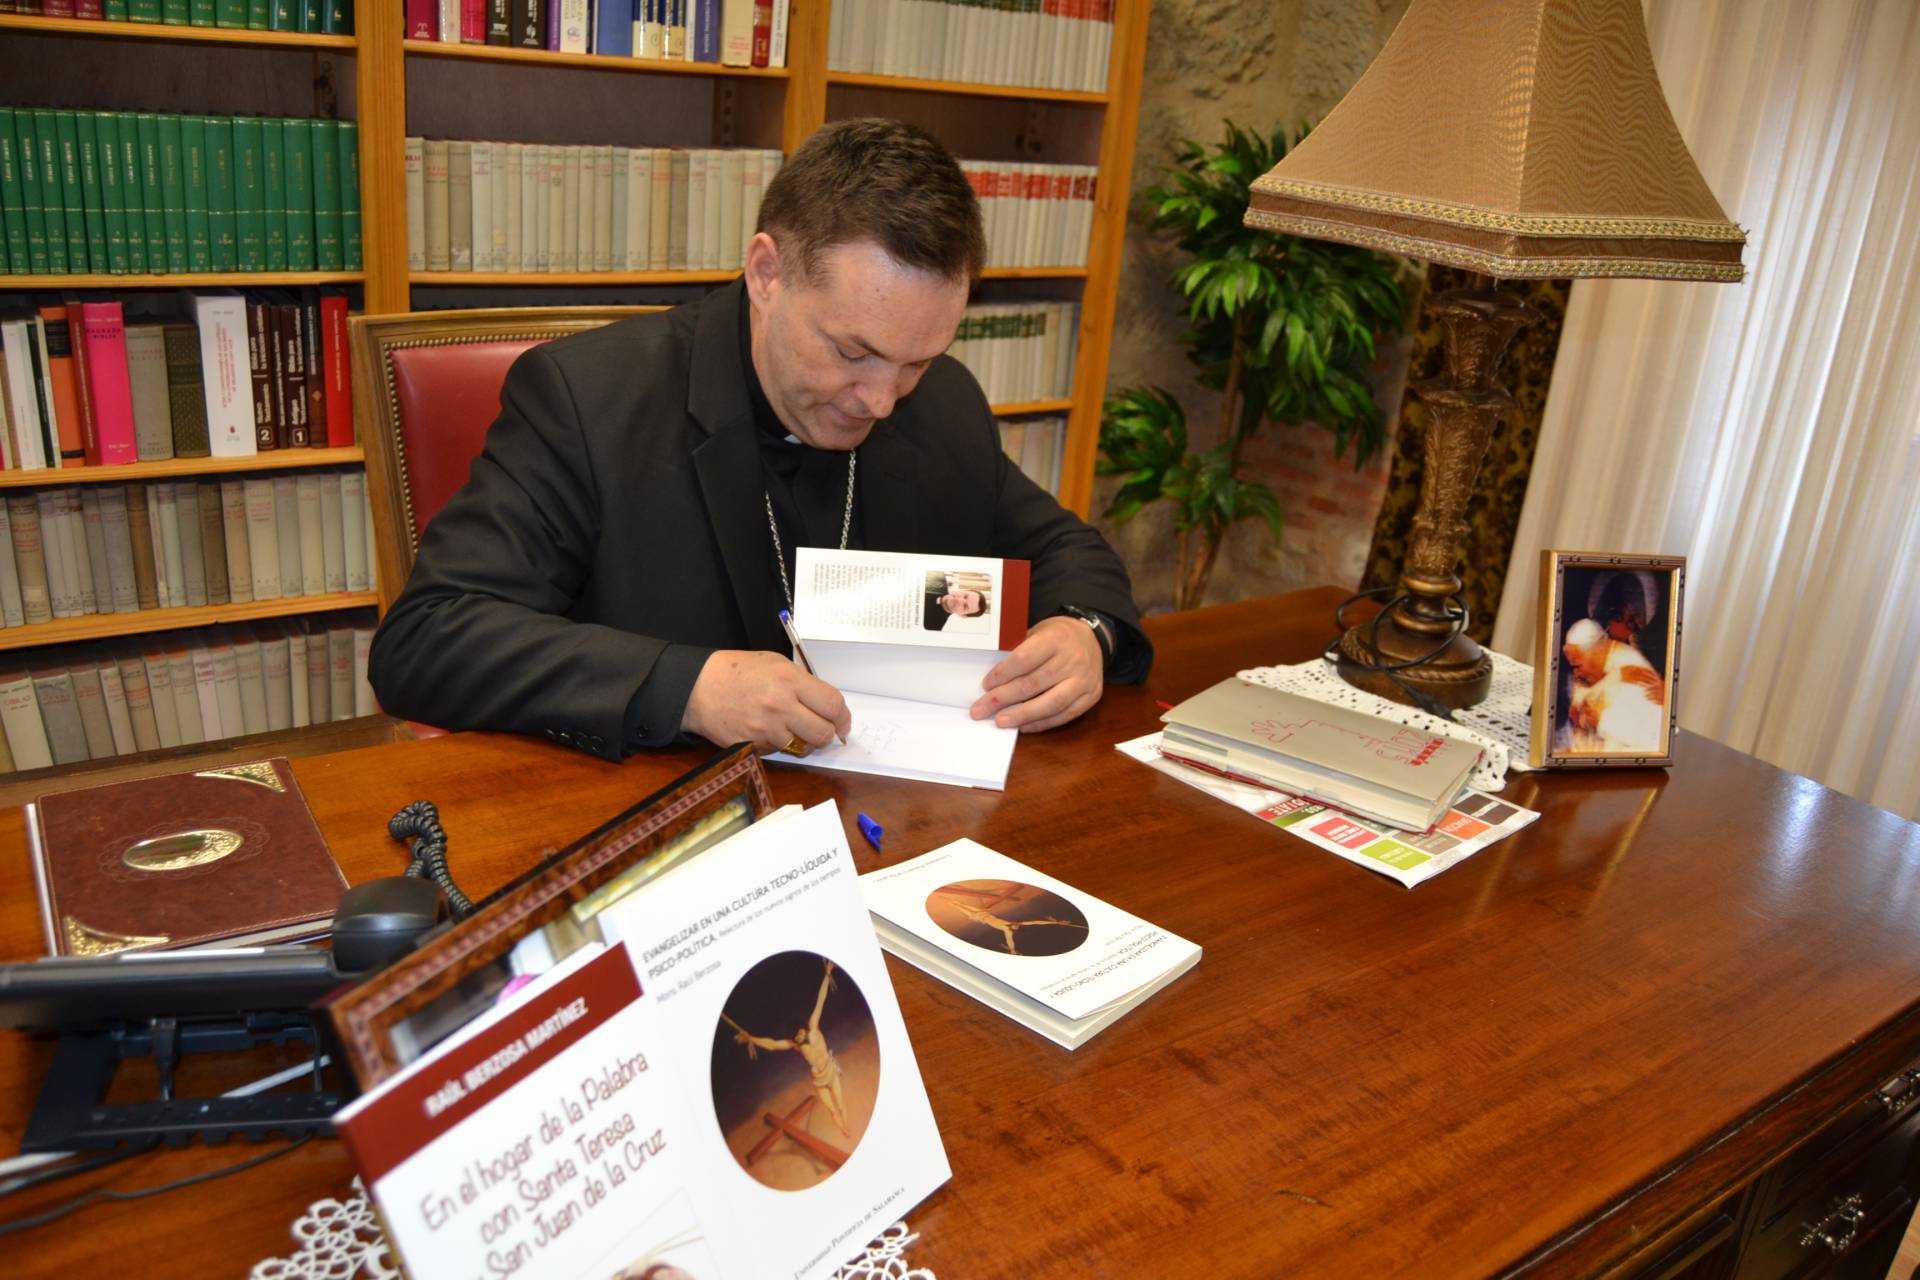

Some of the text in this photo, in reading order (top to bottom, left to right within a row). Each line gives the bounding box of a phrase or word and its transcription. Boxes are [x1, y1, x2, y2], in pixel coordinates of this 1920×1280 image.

[260, 429, 270, 441] 2
[295, 431, 304, 442] 1
[643, 847, 838, 963] EVANGELIZAR EN UNA CULTURA TECNO-LÍQUIDA Y
[694, 960, 721, 980] Berzosa
[463, 1037, 529, 1092] BERZOSA
[524, 996, 589, 1051] MARTÍNEZ
[420, 1051, 649, 1232] En el hogar de la Palabra
[479, 1112, 636, 1246] con Santa Teresa
[485, 1128, 668, 1280] San Juan de la Cruz
